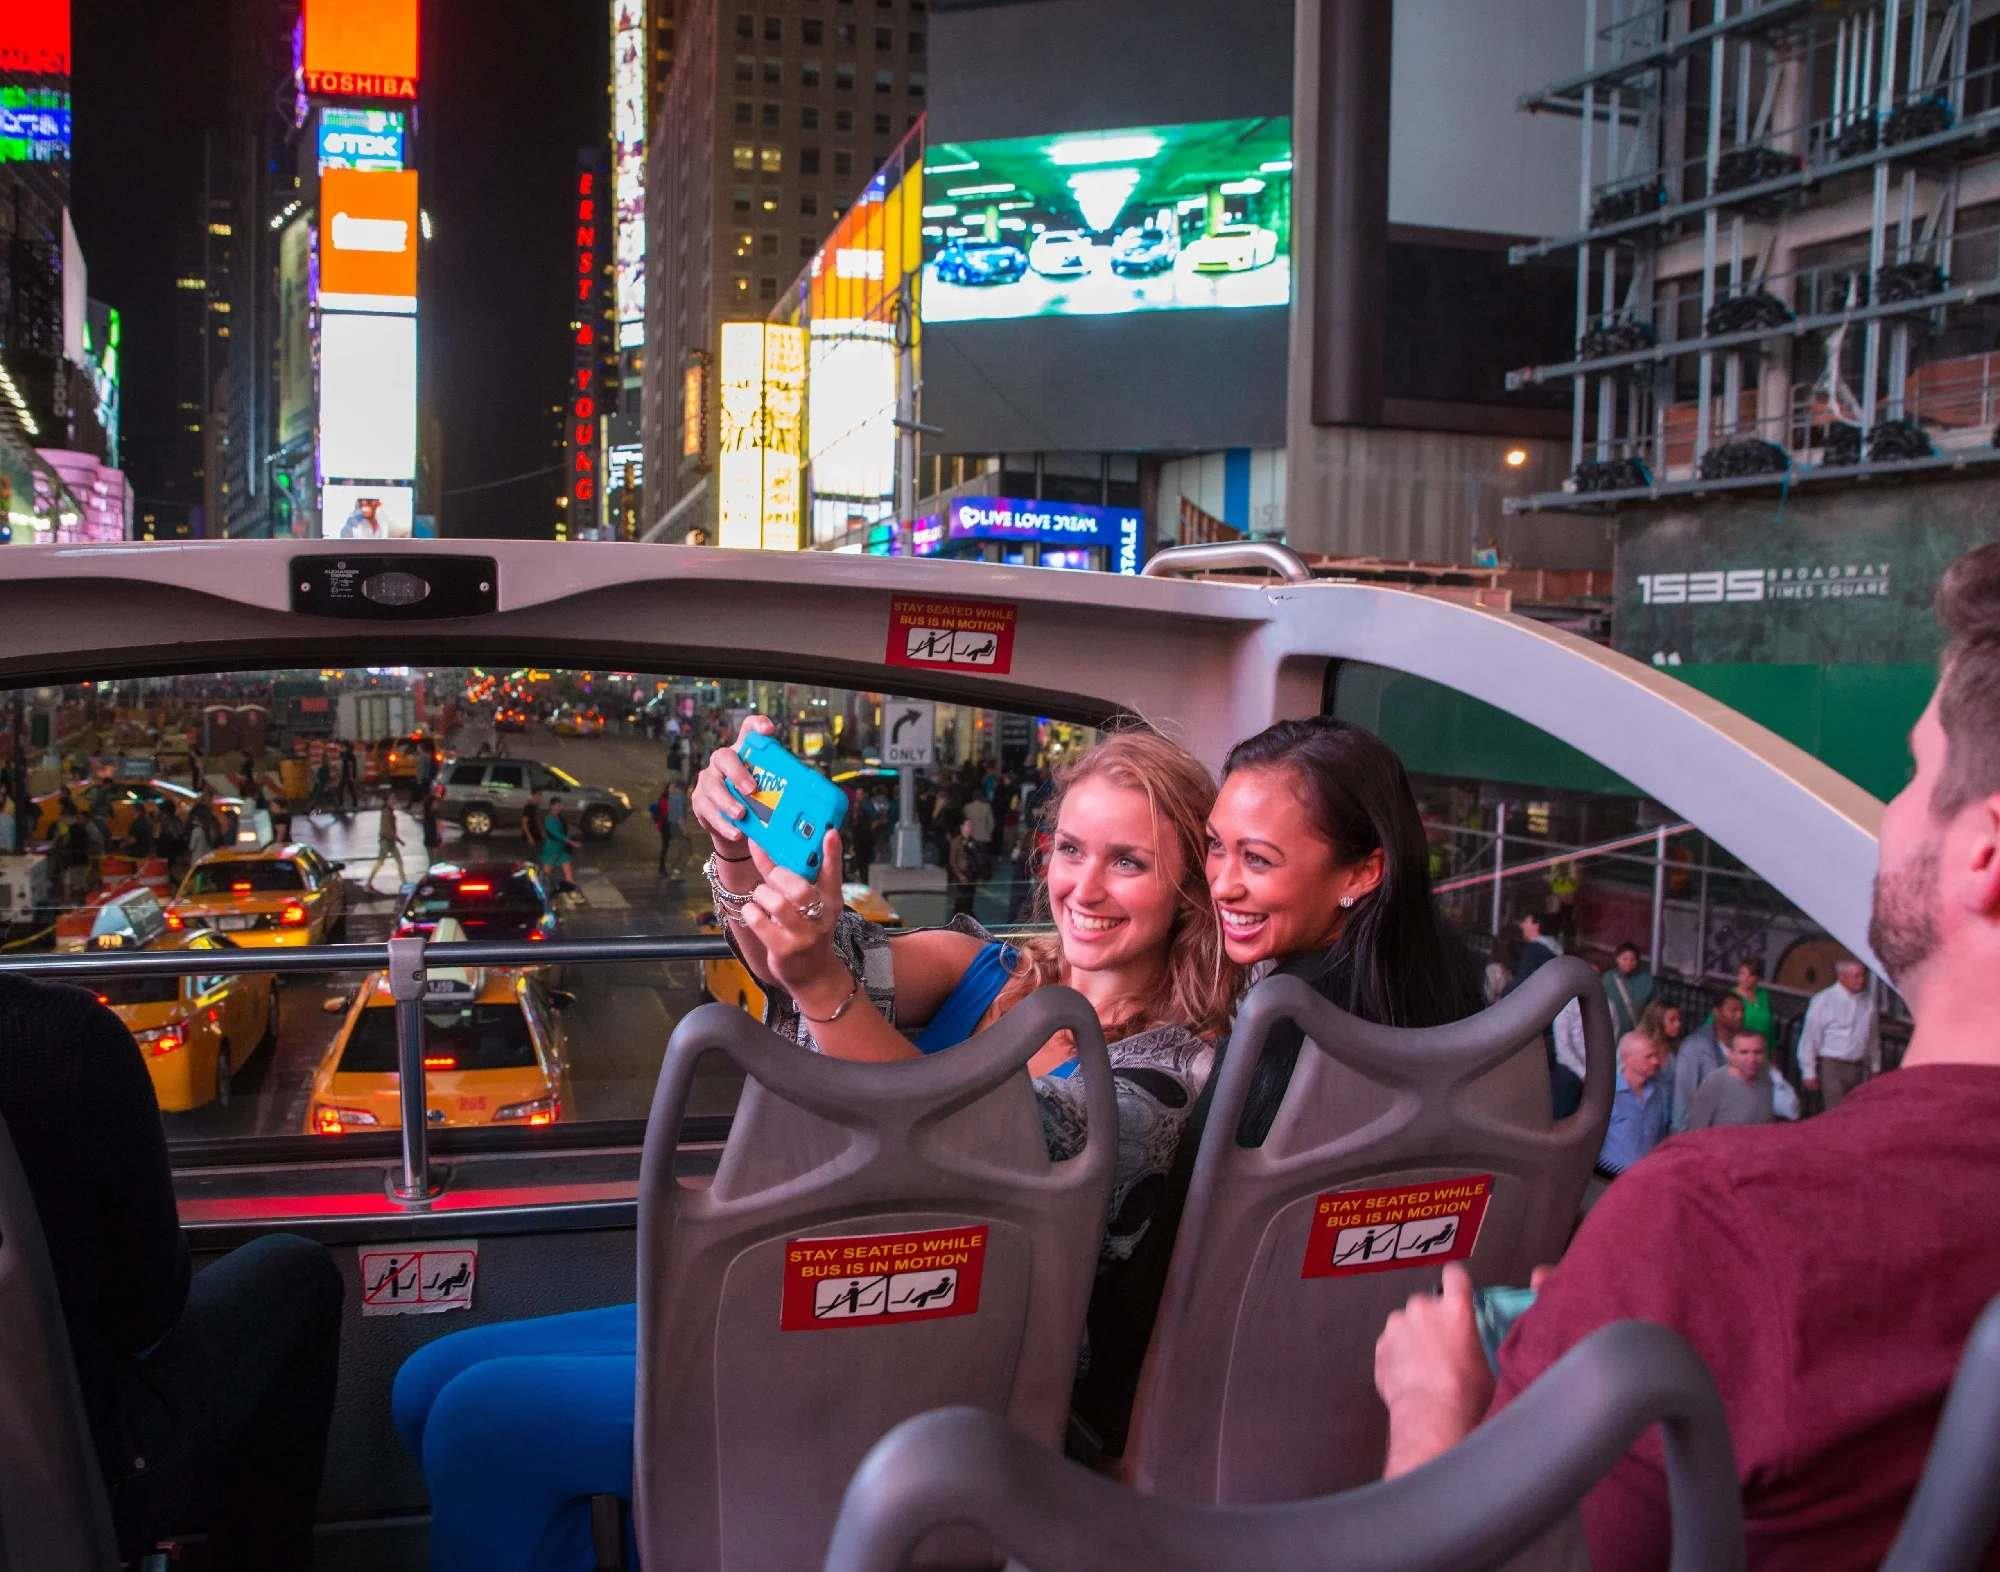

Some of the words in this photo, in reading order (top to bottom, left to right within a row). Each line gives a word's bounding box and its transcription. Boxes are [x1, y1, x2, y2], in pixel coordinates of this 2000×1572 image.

[308, 73, 415, 97] TOSHIBA
[340, 133, 398, 157] TDK
[576, 172, 595, 301] ERNST
[575, 368, 594, 500] YOUNG
[980, 511, 1013, 527] LIVE
[1014, 512, 1051, 530] LOVE
[1637, 569, 1766, 604] 1535
[1767, 563, 1890, 581] BROADWAY
[1768, 584, 1814, 600] TIMES
[1820, 580, 1889, 598] SQUARE
[893, 602, 925, 613] STAY
[926, 604, 973, 617] SEATED
[975, 608, 1015, 620] WHILE
[900, 615, 925, 625] BUS
[928, 617, 939, 627] IS
[942, 618, 955, 628] IN
[957, 619, 1005, 631] MOTION
[889, 749, 926, 761] ONLY
[1319, 1199, 1362, 1214] STAY
[1364, 1191, 1430, 1209] SEATED
[1434, 1183, 1486, 1200] WHILE
[1326, 1214, 1362, 1228] BUS
[1366, 1211, 1382, 1224] IS
[1385, 1209, 1404, 1221] IN
[1407, 1200, 1472, 1218] MOTION
[790, 1248, 839, 1263] STAY
[842, 1242, 918, 1260] SEATED
[922, 1235, 983, 1252] WHILE
[801, 1264, 841, 1278] BUS
[846, 1262, 864, 1275] IS
[869, 1260, 889, 1273] IN
[894, 1252, 969, 1271] MOTION
